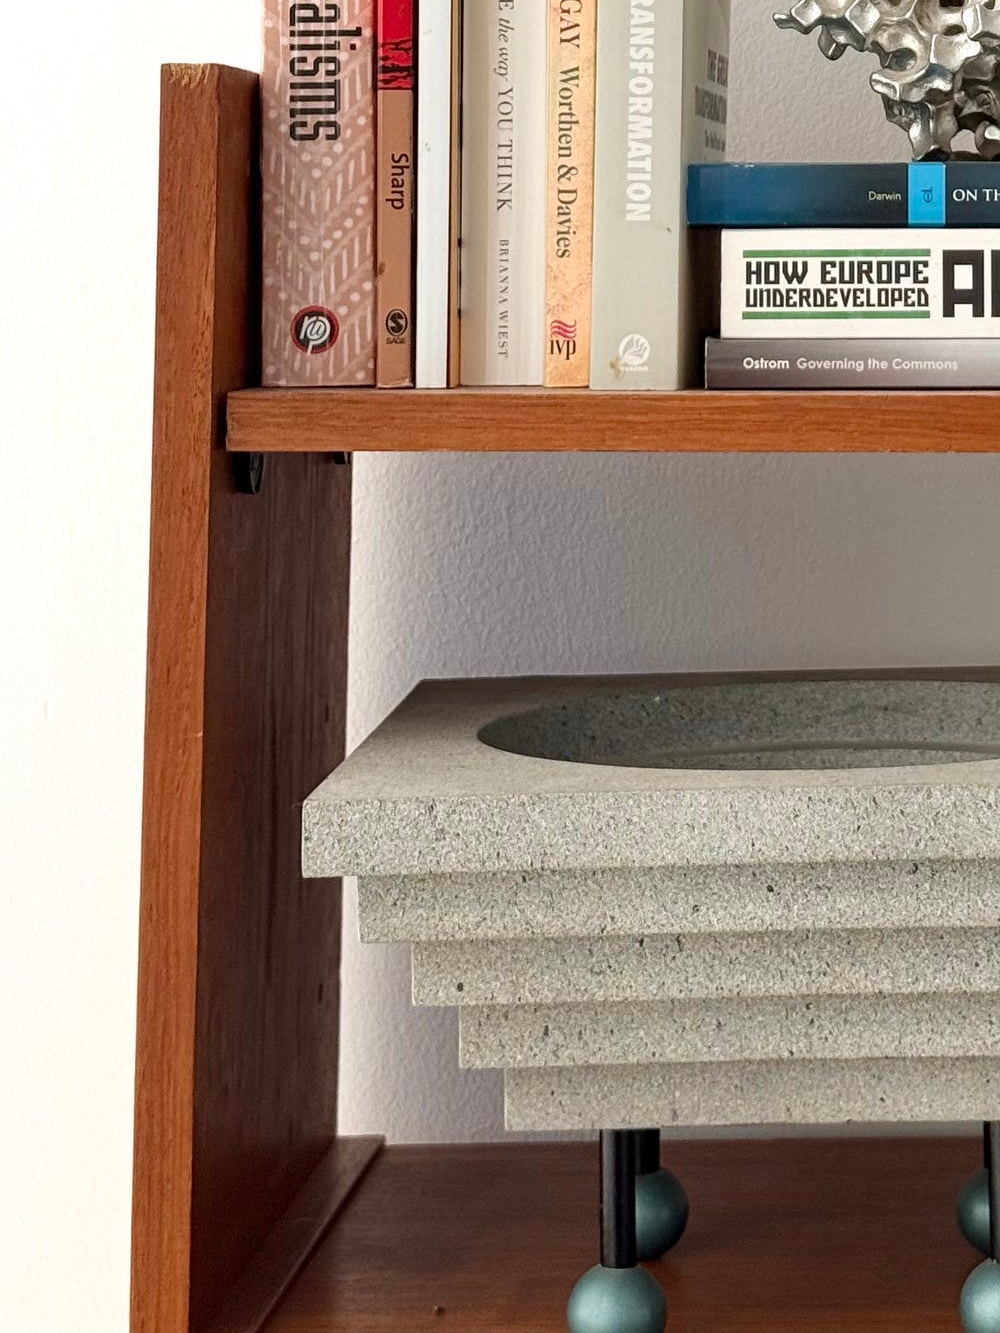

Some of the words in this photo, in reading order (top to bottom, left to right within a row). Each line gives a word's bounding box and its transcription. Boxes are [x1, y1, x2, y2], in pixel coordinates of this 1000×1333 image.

[499, 19, 514, 43] the
[494, 47, 509, 82] way
[497, 87, 514, 131] YOU
[557, 66, 580, 158] Worthen
[386, 153, 409, 210] Sharp
[496, 139, 513, 211] THINK
[557, 163, 579, 184] &
[868, 191, 902, 201] Darwin
[952, 188, 978, 202] ON
[556, 189, 577, 259] Davies
[498, 239, 509, 305] BRIANNA
[745, 261, 809, 285] HOW
[820, 260, 929, 285] EUROPE
[745, 287, 929, 308] UNDERDEVELOPED
[497, 310, 509, 359] WIEST
[743, 357, 790, 370] Ostrom
[797, 357, 864, 372] Governing
[867, 357, 888, 370] the
[892, 358, 958, 371] Commons
